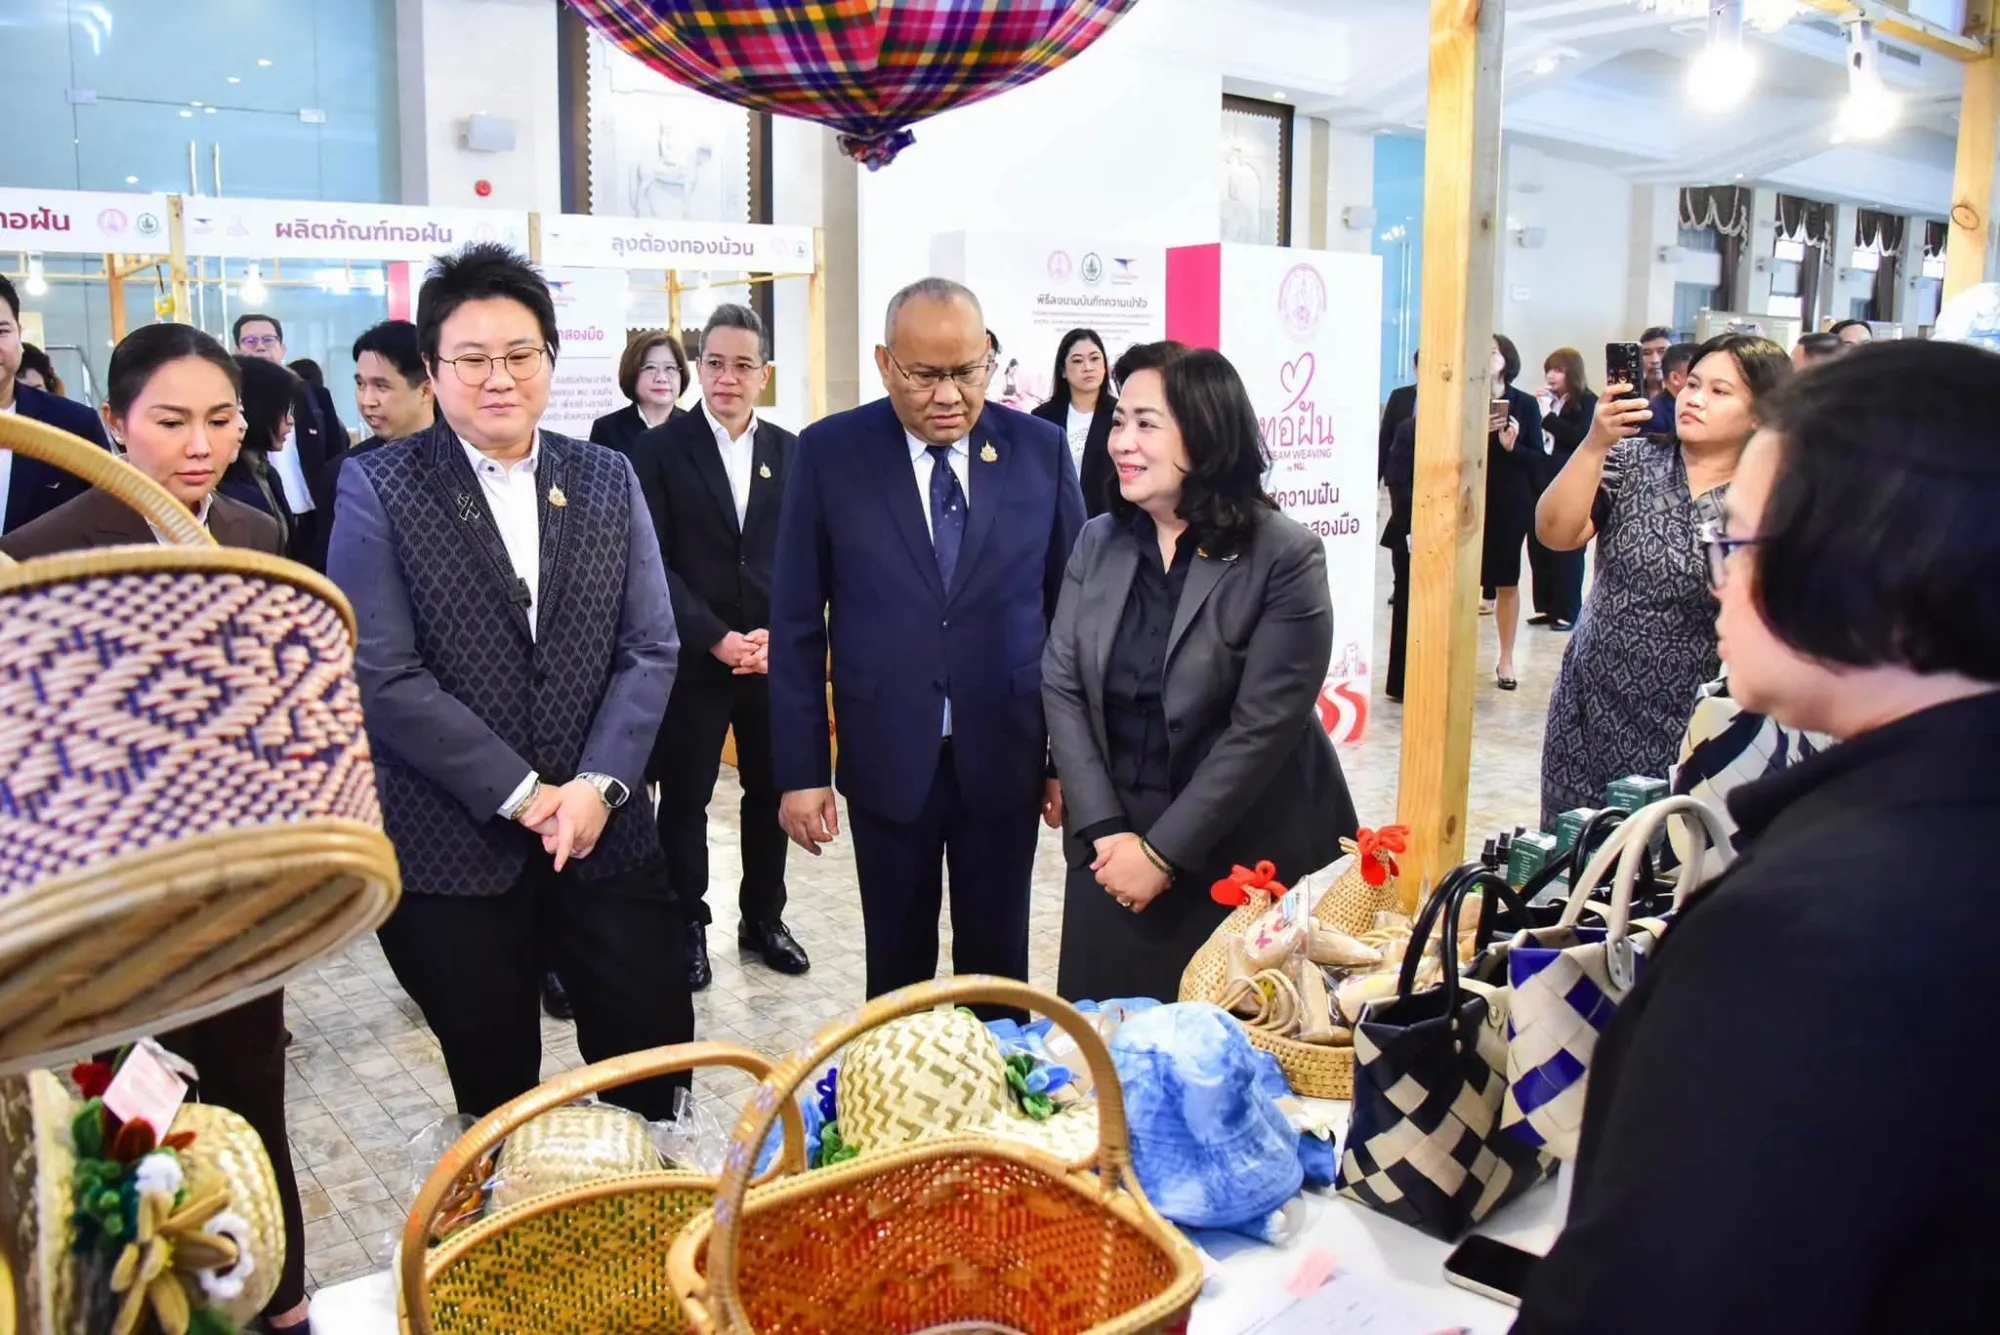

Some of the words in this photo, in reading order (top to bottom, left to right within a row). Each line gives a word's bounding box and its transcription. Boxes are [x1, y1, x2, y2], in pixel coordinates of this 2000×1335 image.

[275, 218, 453, 243] ผลิตภัณฑ์ทอฝัน
[1292, 448, 1332, 460] WEAVING
